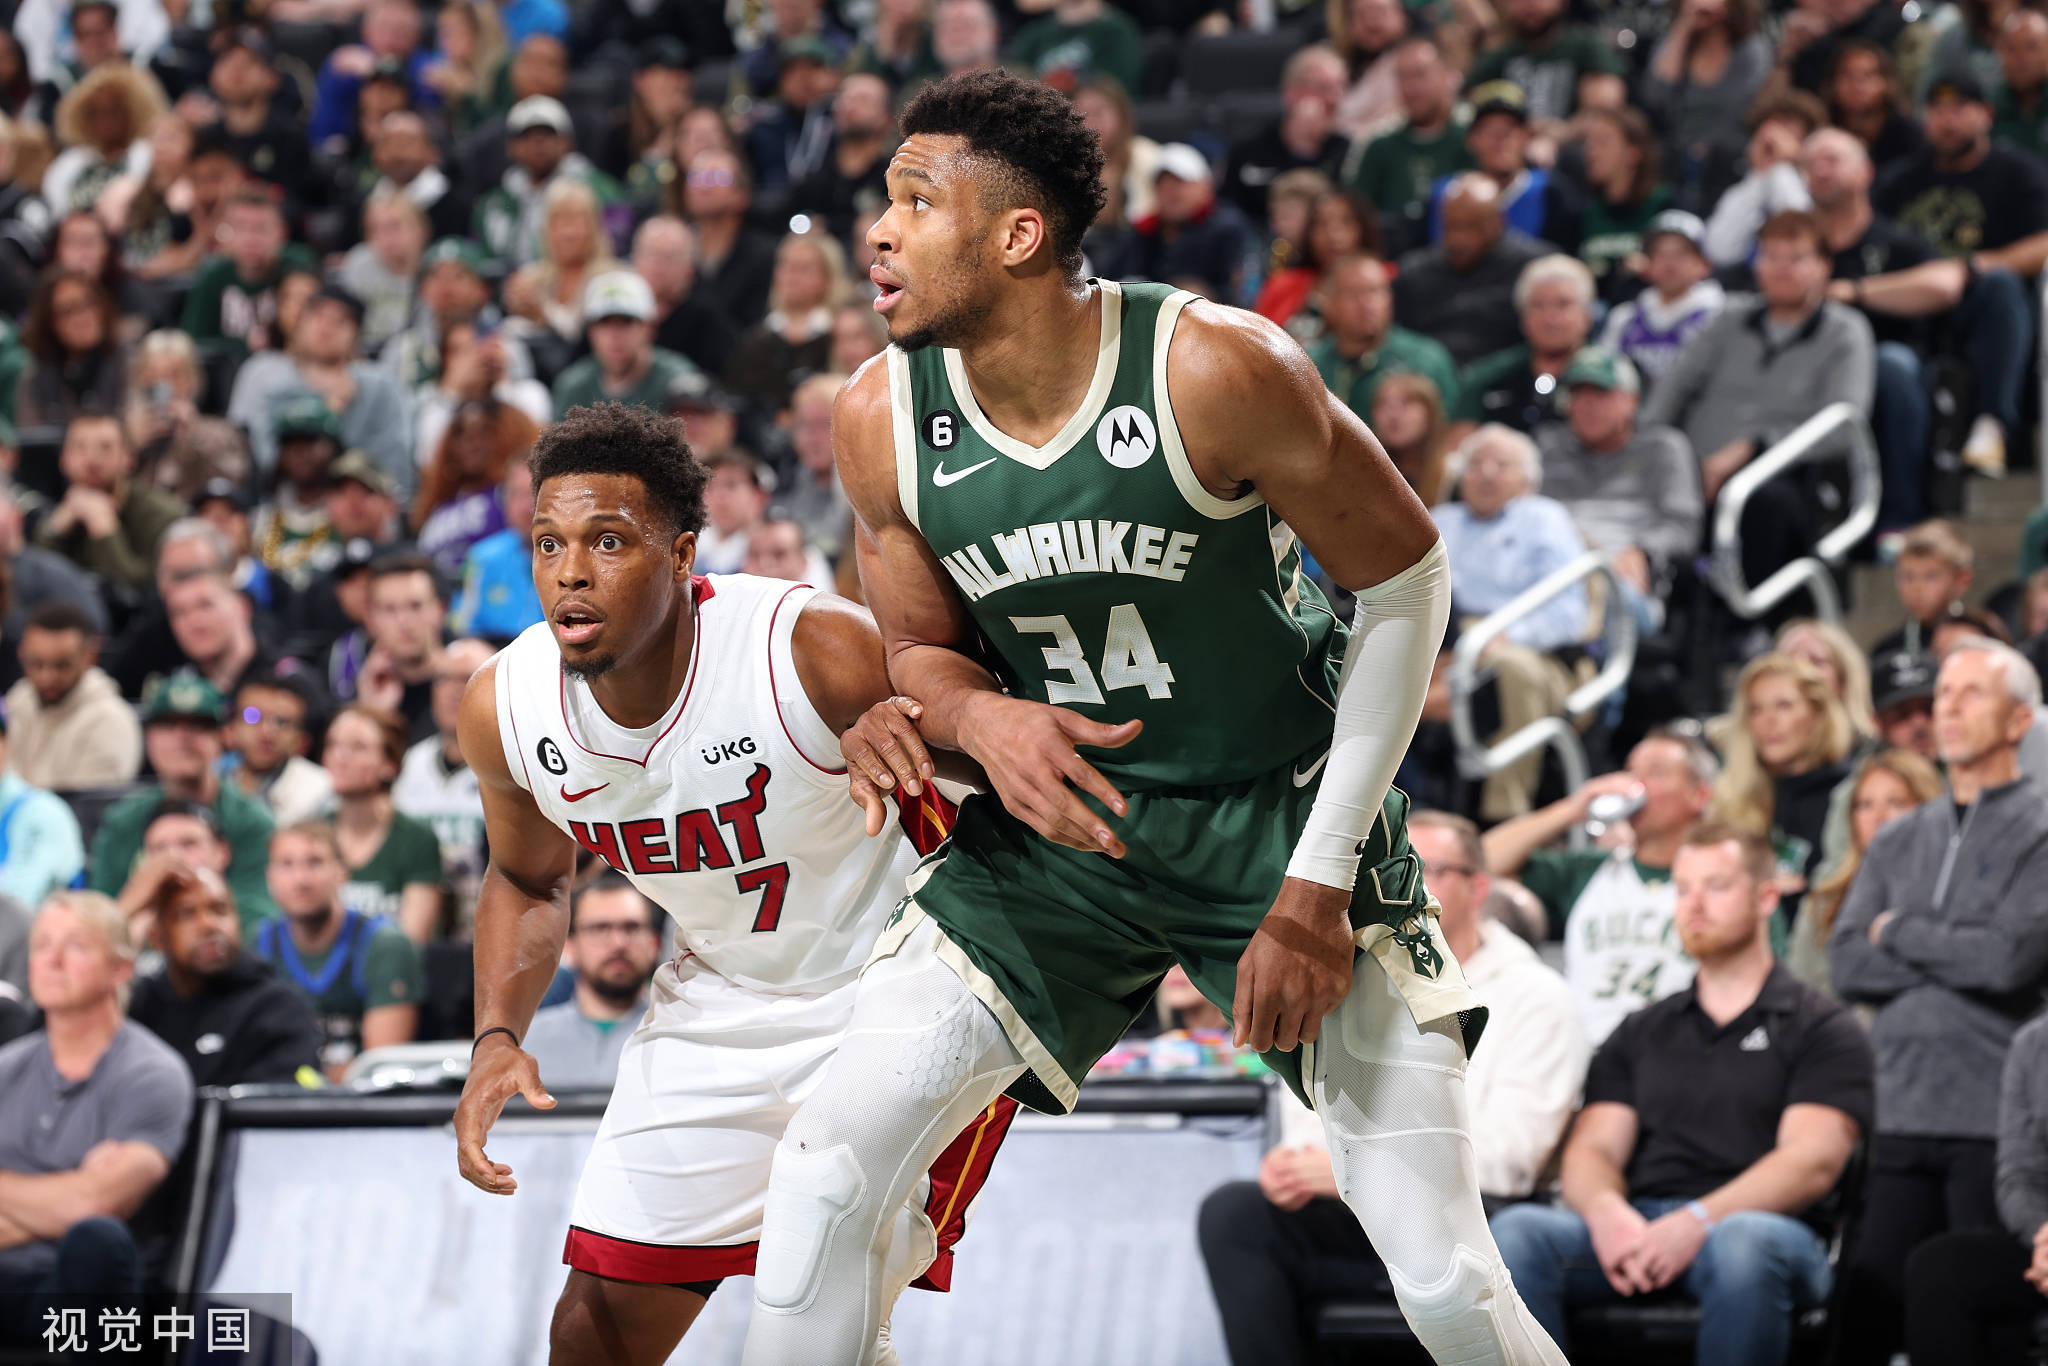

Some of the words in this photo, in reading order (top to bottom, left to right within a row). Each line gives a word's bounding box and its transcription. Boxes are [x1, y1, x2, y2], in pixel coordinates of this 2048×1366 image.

[932, 416, 953, 447] 6
[939, 519, 1199, 602] MILWAUKEE
[1007, 602, 1176, 705] 34
[545, 743, 566, 772] 6
[567, 762, 772, 875] HEAT
[734, 861, 791, 933] 7
